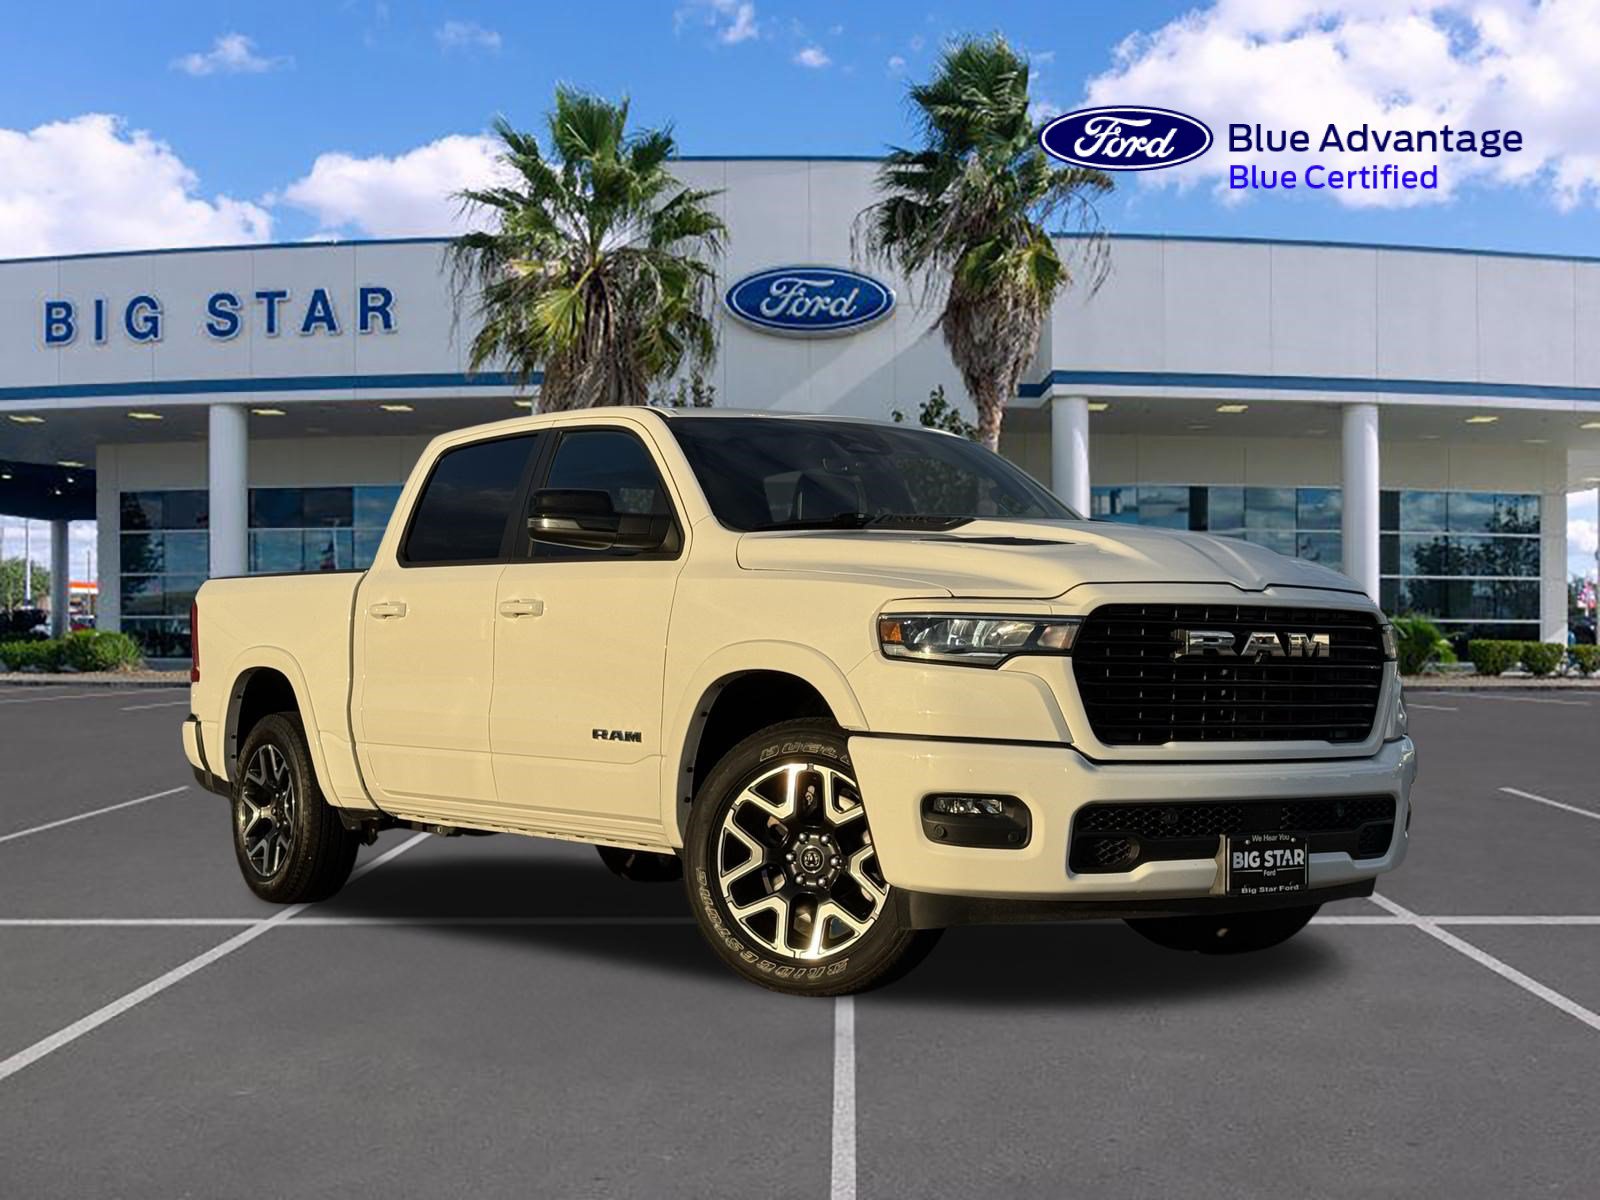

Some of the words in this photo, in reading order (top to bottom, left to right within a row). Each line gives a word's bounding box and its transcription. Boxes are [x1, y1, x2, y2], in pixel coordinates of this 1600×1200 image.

[759, 277, 860, 317] Ford
[43, 294, 164, 345] BIG
[205, 286, 398, 341] STAR
[1174, 629, 1331, 660] RAM
[591, 727, 642, 744] RAM
[1232, 851, 1261, 869] BIG
[1264, 849, 1304, 867] STAR
[1241, 886, 1256, 894] Big
[1259, 885, 1278, 893] Star
[1279, 884, 1299, 892] Ford
